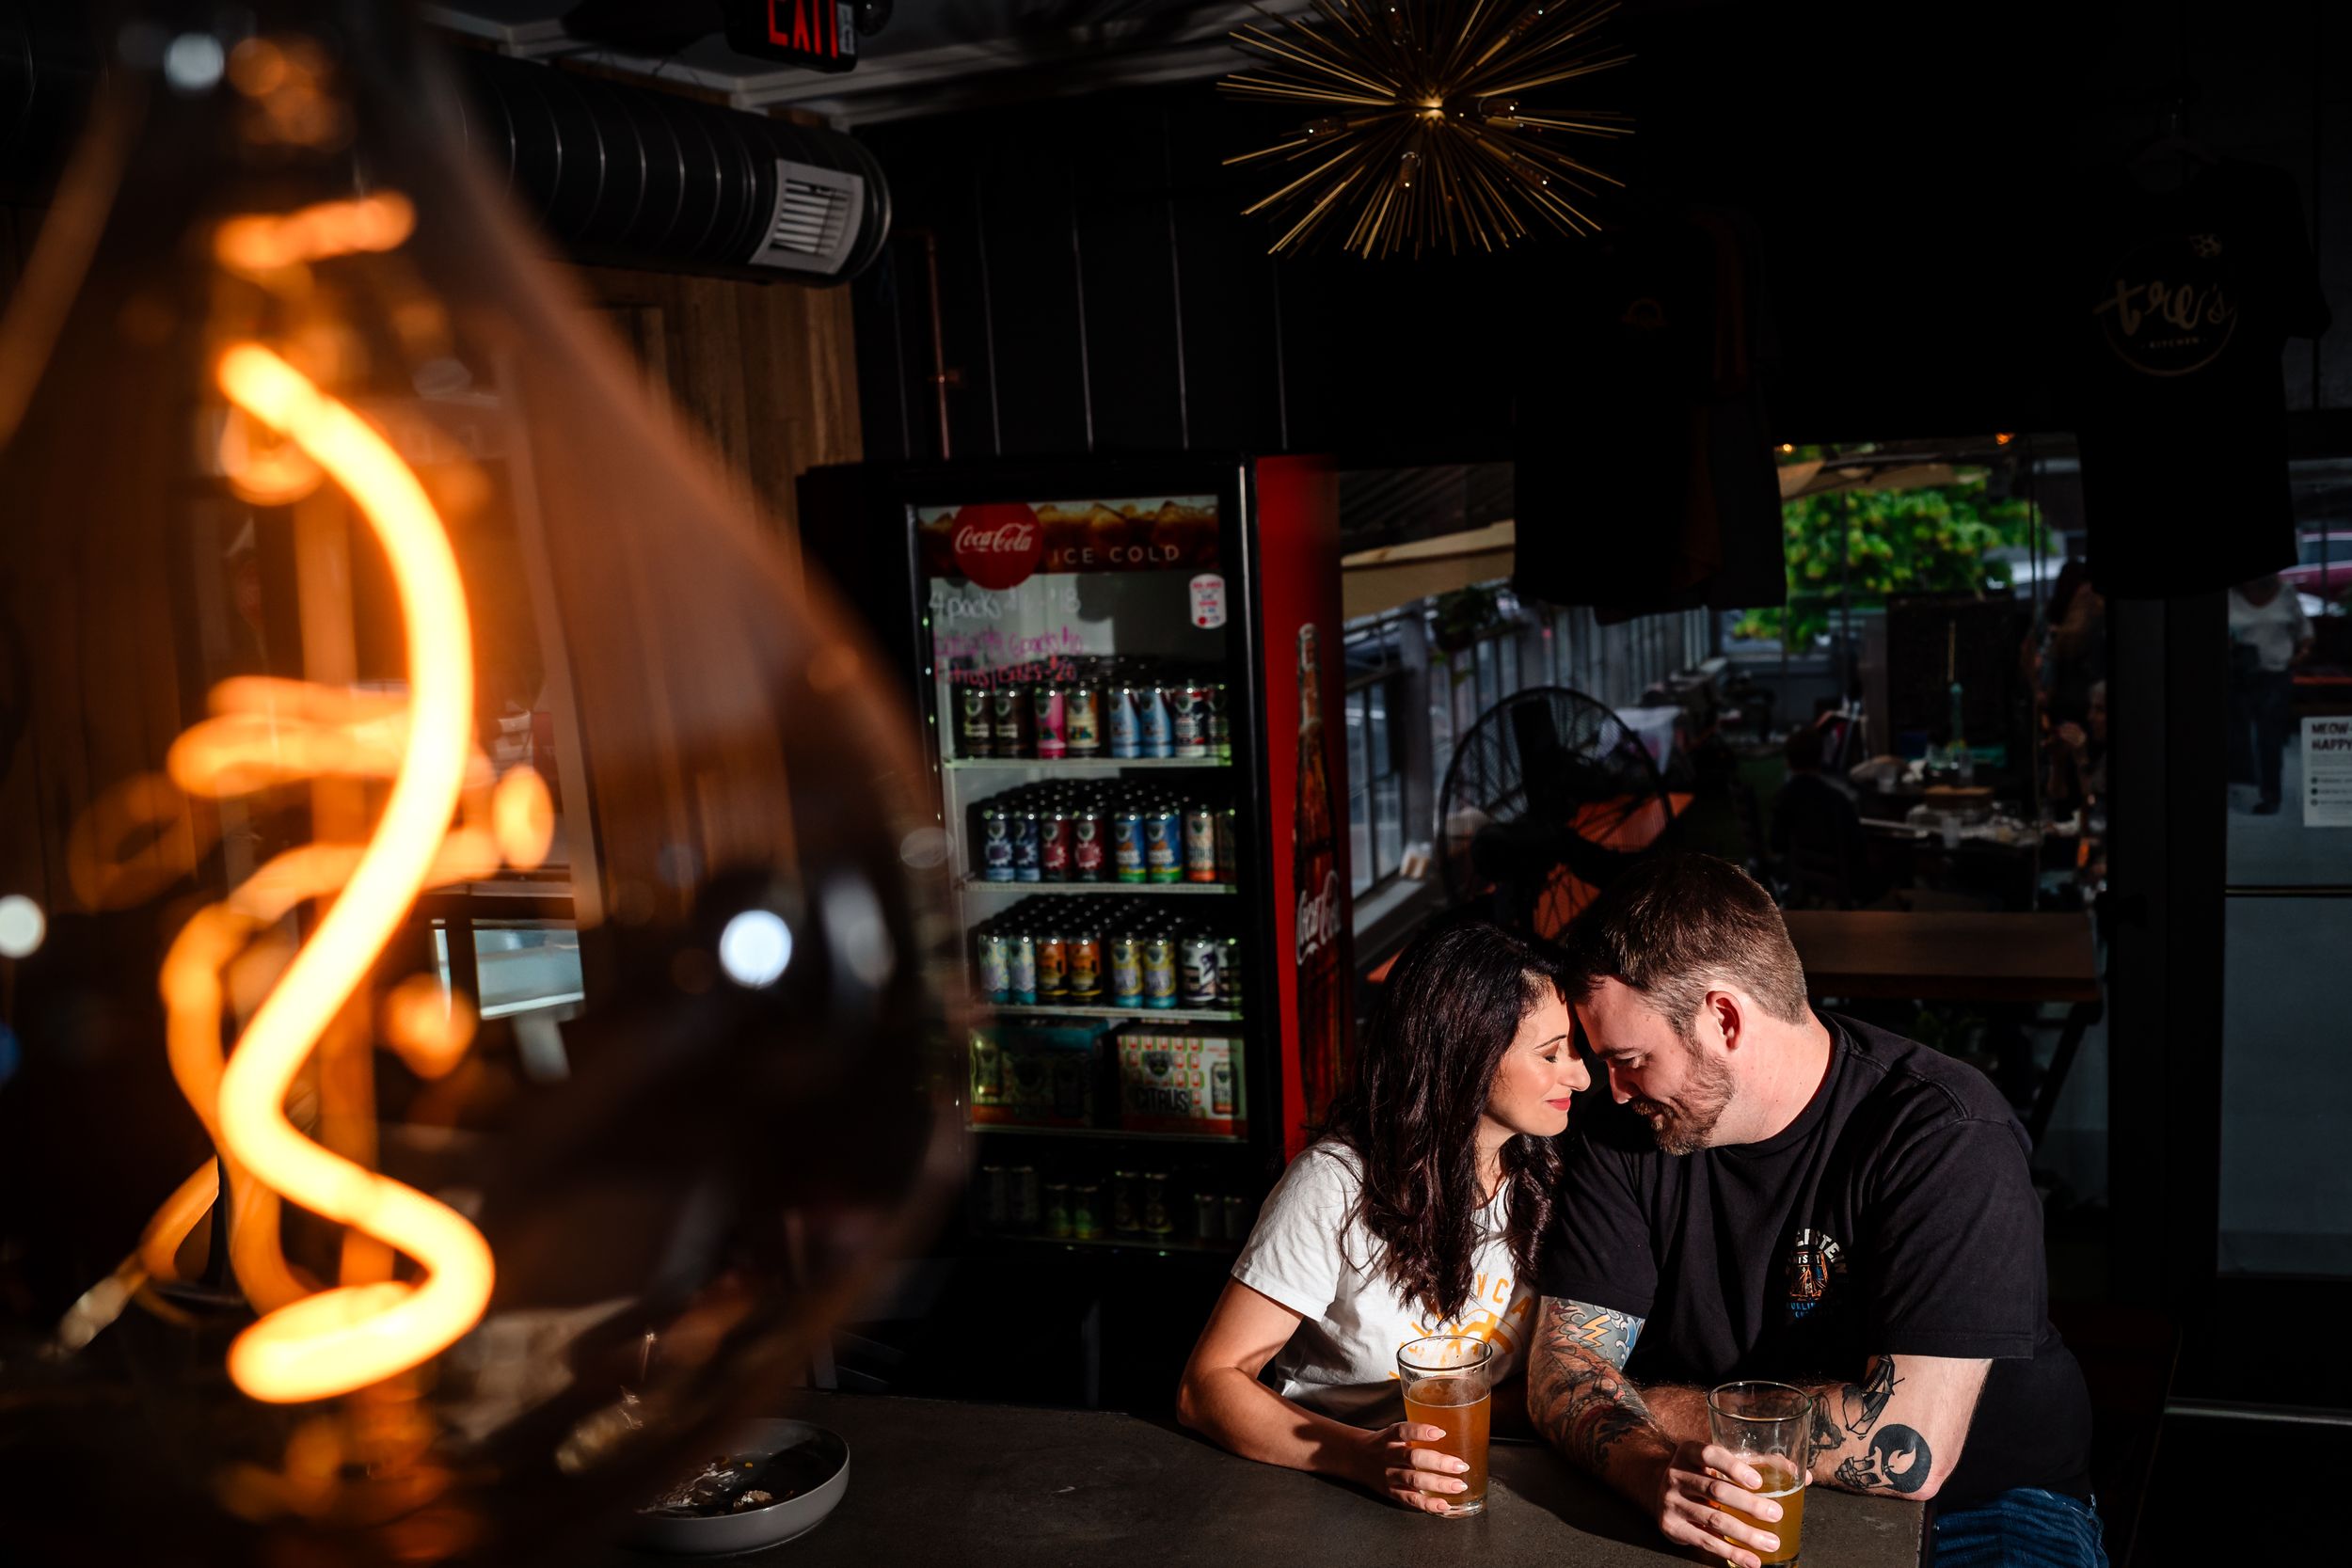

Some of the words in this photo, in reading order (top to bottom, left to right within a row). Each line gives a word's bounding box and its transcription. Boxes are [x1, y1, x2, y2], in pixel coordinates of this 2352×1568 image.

[1053, 546, 1095, 564] ICE
[1108, 544, 1181, 562] COLD
[1136, 1086, 1190, 1115] CITRUS
